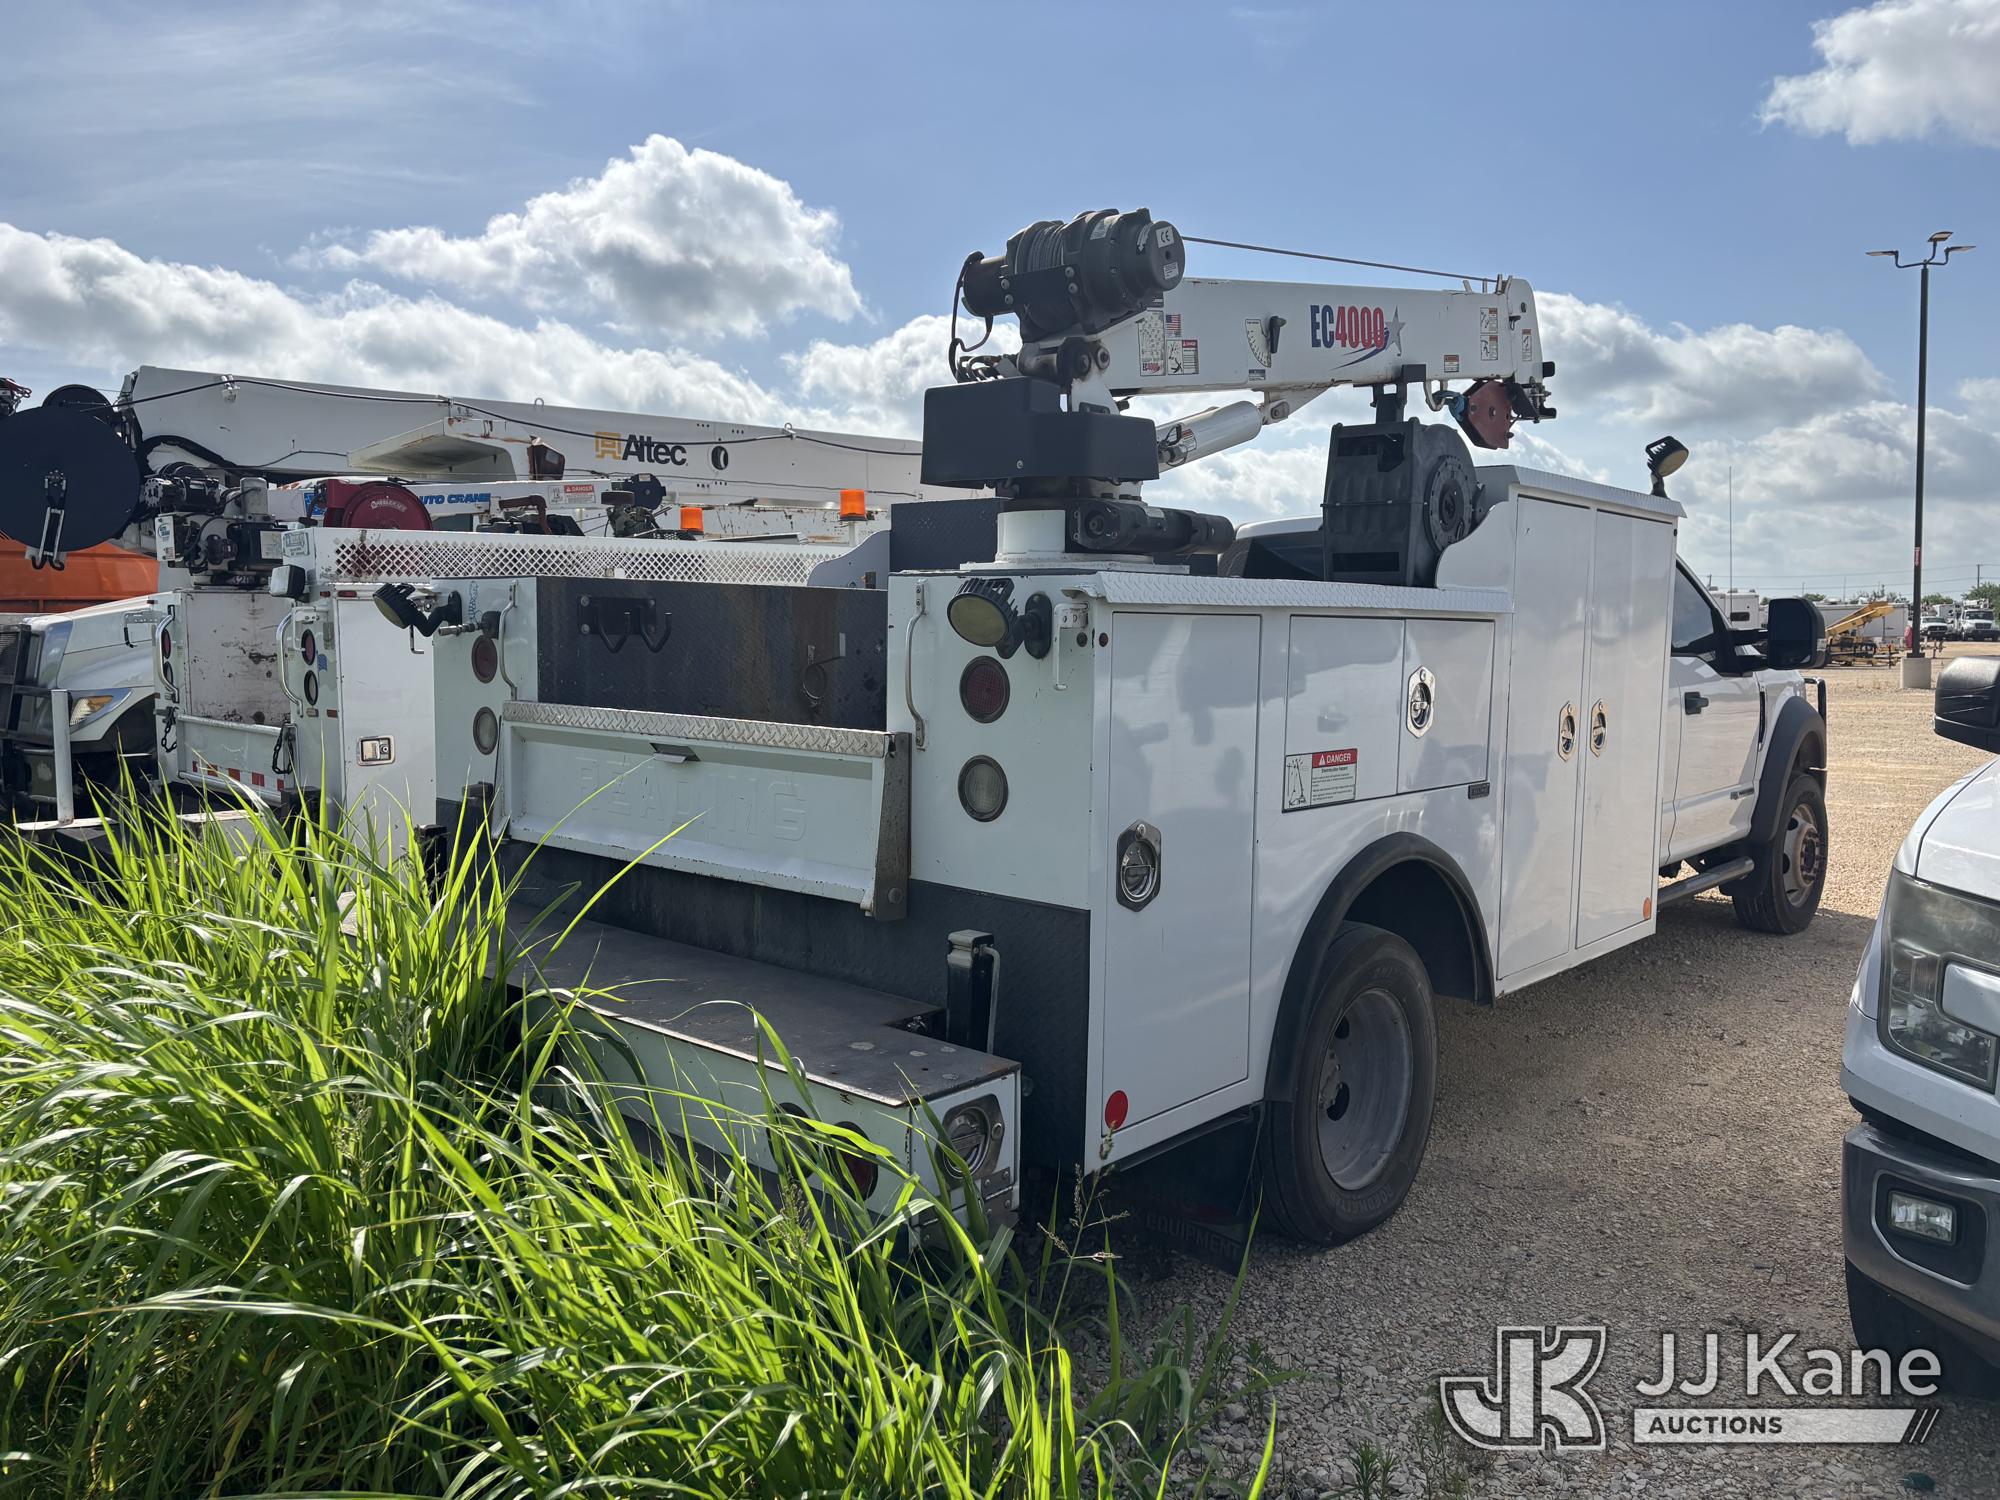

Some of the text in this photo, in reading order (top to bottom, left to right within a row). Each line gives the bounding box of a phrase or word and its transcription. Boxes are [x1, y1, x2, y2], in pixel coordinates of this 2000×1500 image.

[1310, 304, 1385, 350] EC4000
[621, 434, 687, 466] Altec
[419, 492, 491, 505] UTO CRANE
[1326, 753, 1352, 764] DANGER
[574, 756, 807, 842] READING
